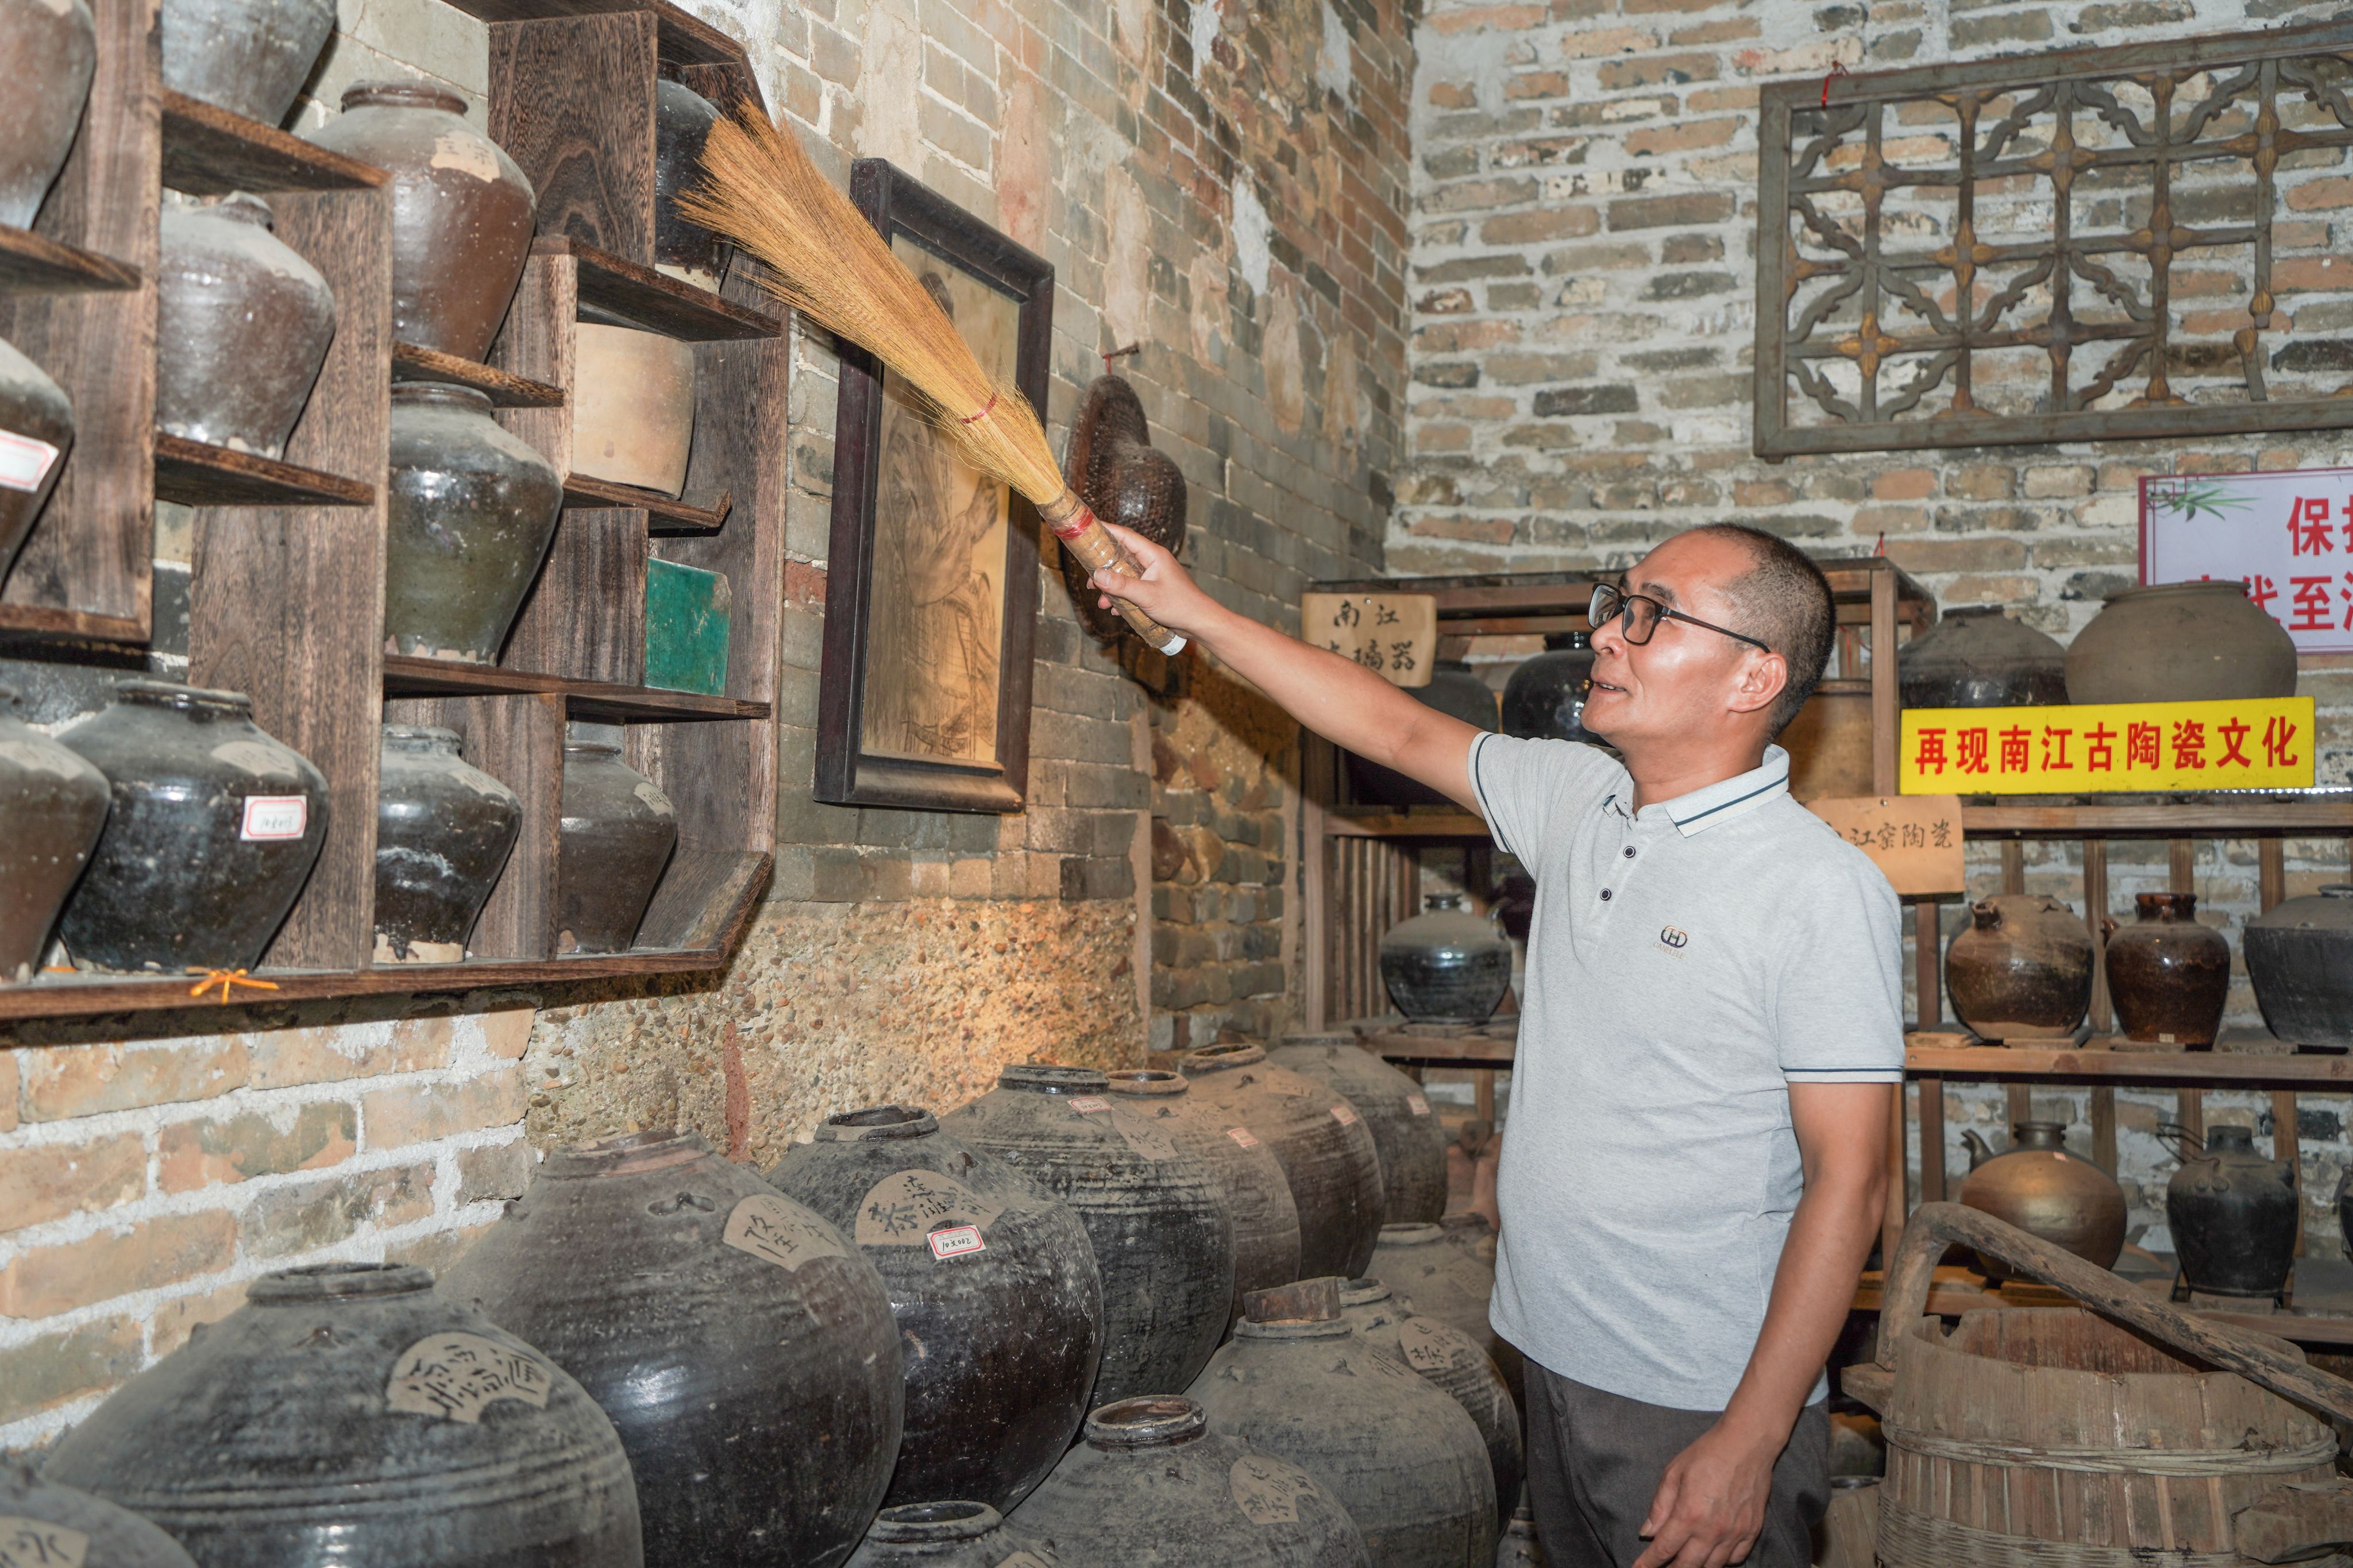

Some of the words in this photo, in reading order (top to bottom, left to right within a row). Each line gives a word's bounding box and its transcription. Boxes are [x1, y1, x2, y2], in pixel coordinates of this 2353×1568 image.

[2286, 495, 2353, 557] 保
[1333, 600, 1401, 627] 南江
[1915, 716, 2298, 775] 再现南江古陶瓷文化
